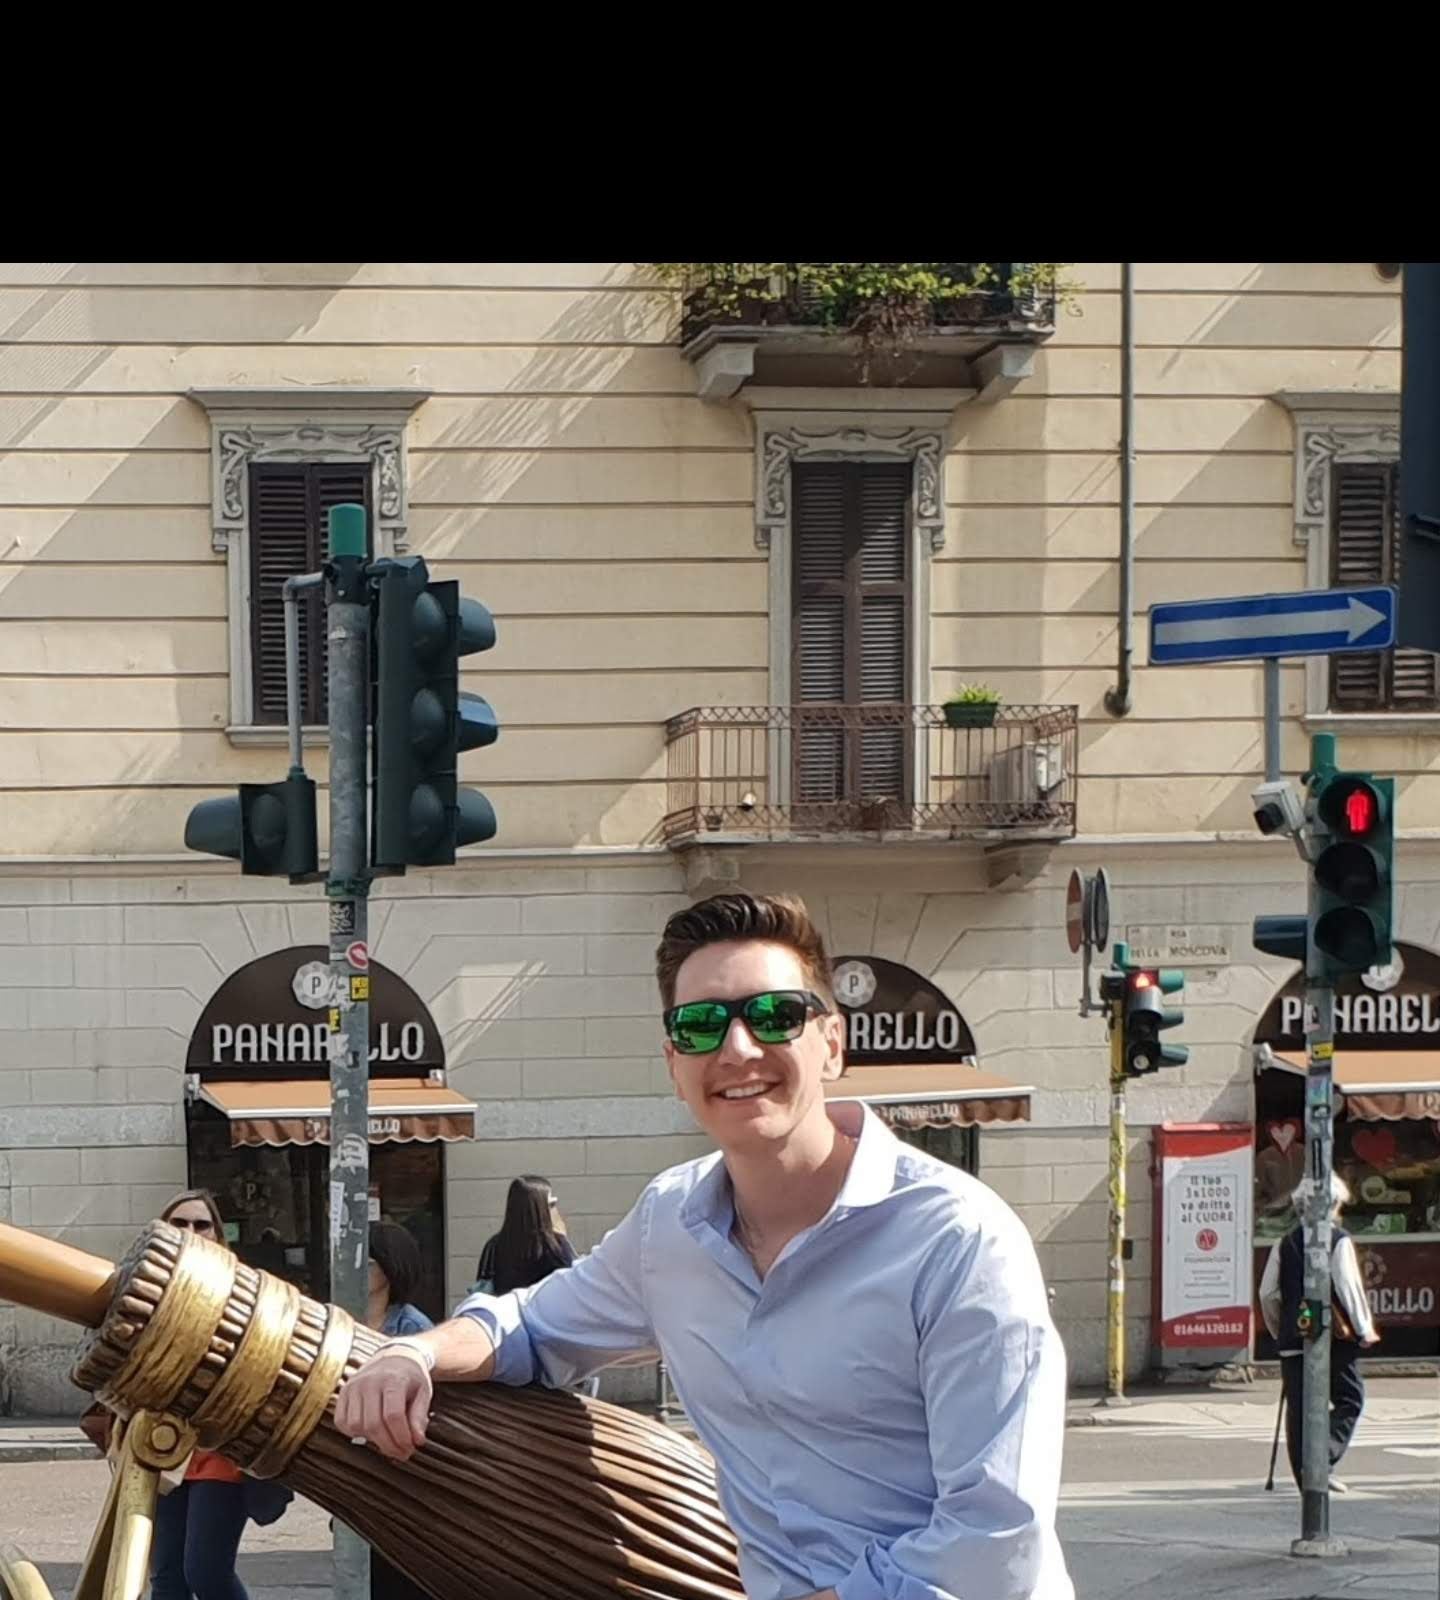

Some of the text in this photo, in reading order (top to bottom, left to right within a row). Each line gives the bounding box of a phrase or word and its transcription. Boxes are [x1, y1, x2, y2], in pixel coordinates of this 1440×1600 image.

[1169, 945, 1228, 957] MOSCOVA
[1202, 1174, 1222, 1186] tuo
[1181, 1200, 1231, 1211] va dritto
[1196, 1211, 1234, 1223] CUORE
